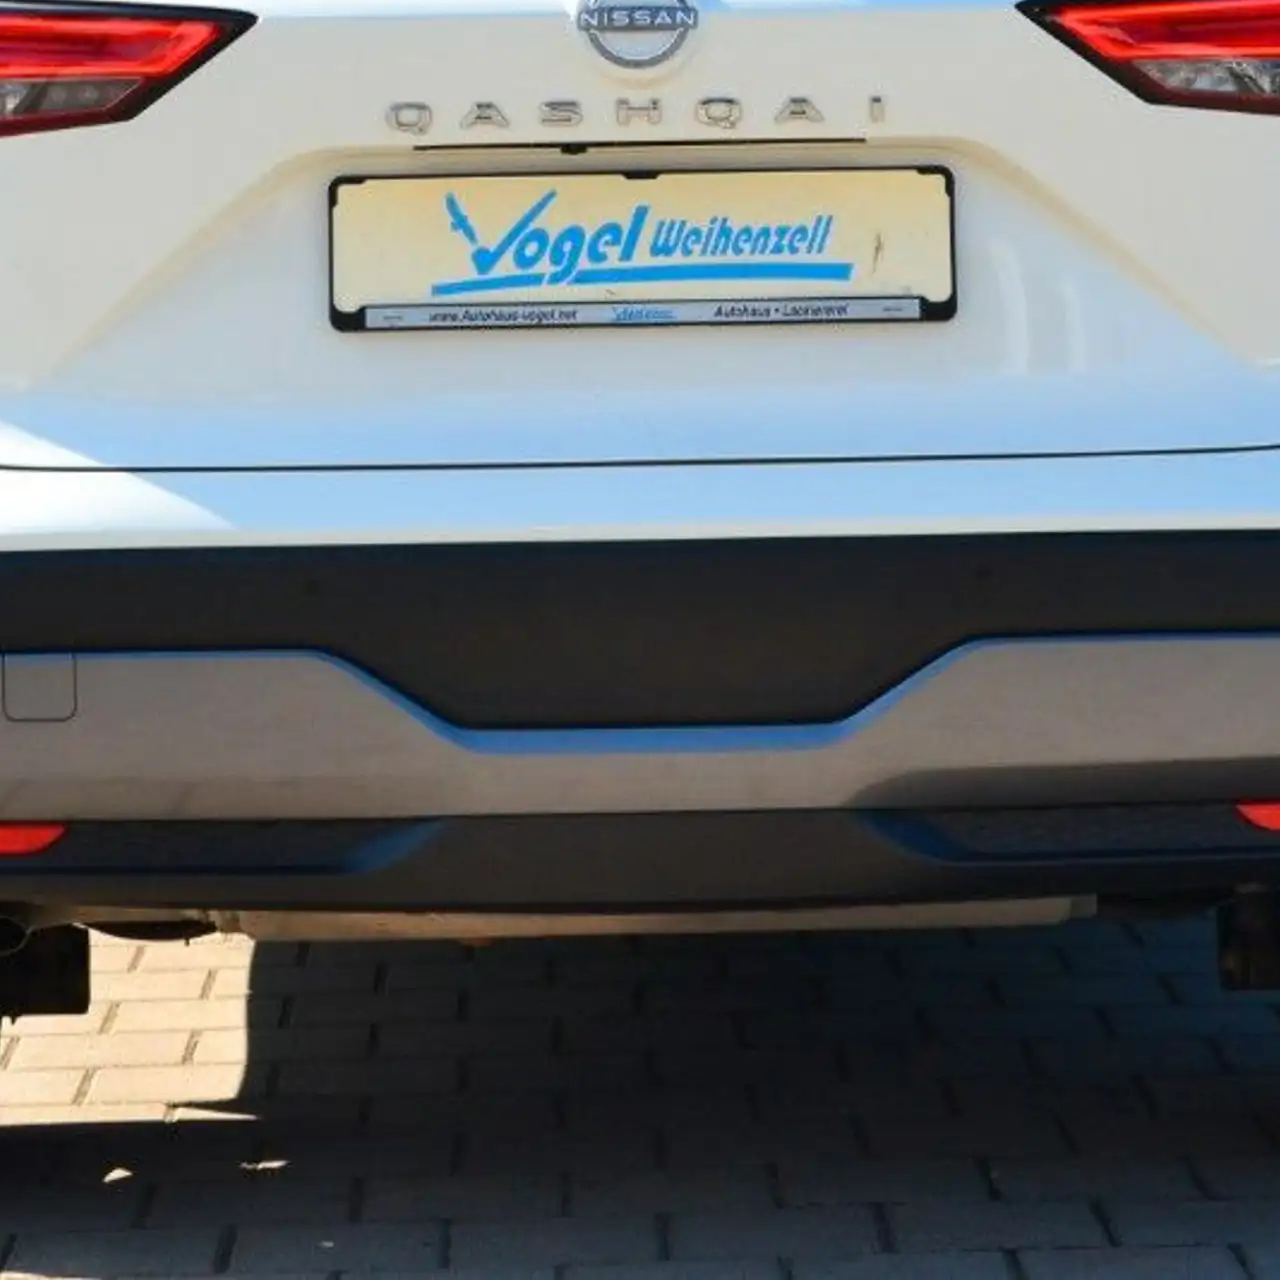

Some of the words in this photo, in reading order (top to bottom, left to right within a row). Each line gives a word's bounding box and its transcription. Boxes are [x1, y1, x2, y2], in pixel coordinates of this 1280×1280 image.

[579, 9, 696, 29] NISSAN
[385, 94, 888, 135] QASHQAI
[445, 189, 650, 283] Vogel
[650, 216, 833, 258] Weihenzell
